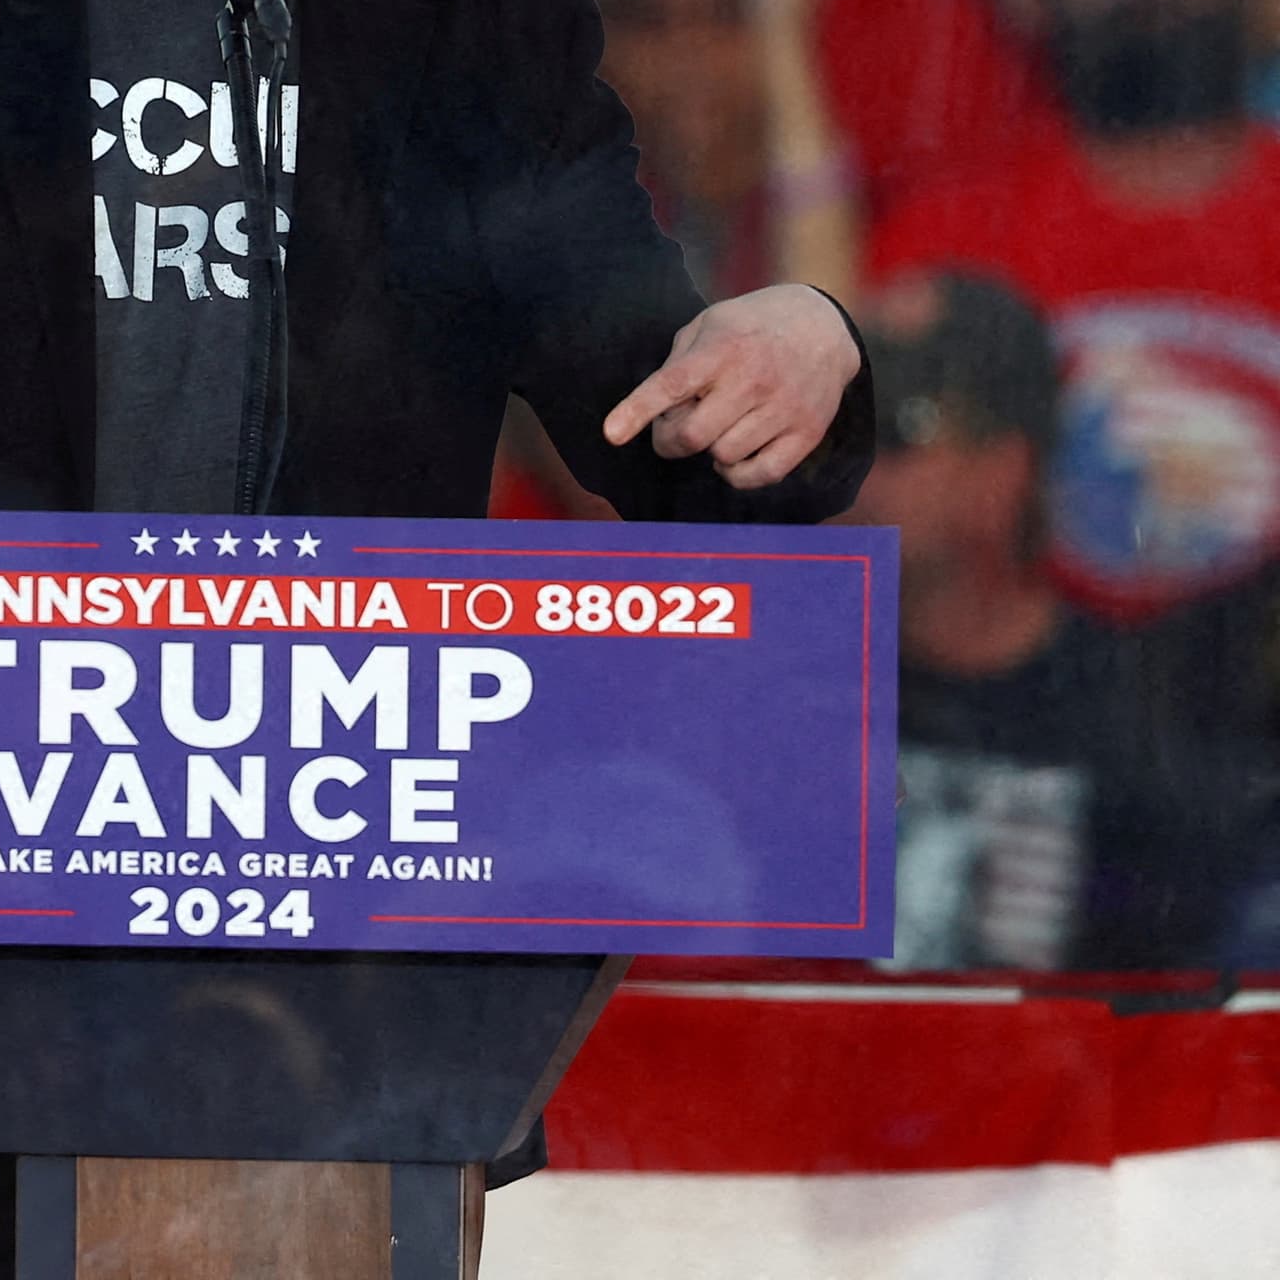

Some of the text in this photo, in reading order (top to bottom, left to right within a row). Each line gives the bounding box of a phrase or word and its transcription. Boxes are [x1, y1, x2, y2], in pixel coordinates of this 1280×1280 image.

[427, 582, 513, 631] TO
[535, 584, 735, 634] 88022
[65, 849, 226, 876] AMERICA
[238, 852, 355, 879] GREAT
[367, 854, 493, 881] AGAIN!
[129, 886, 314, 938] 2024
